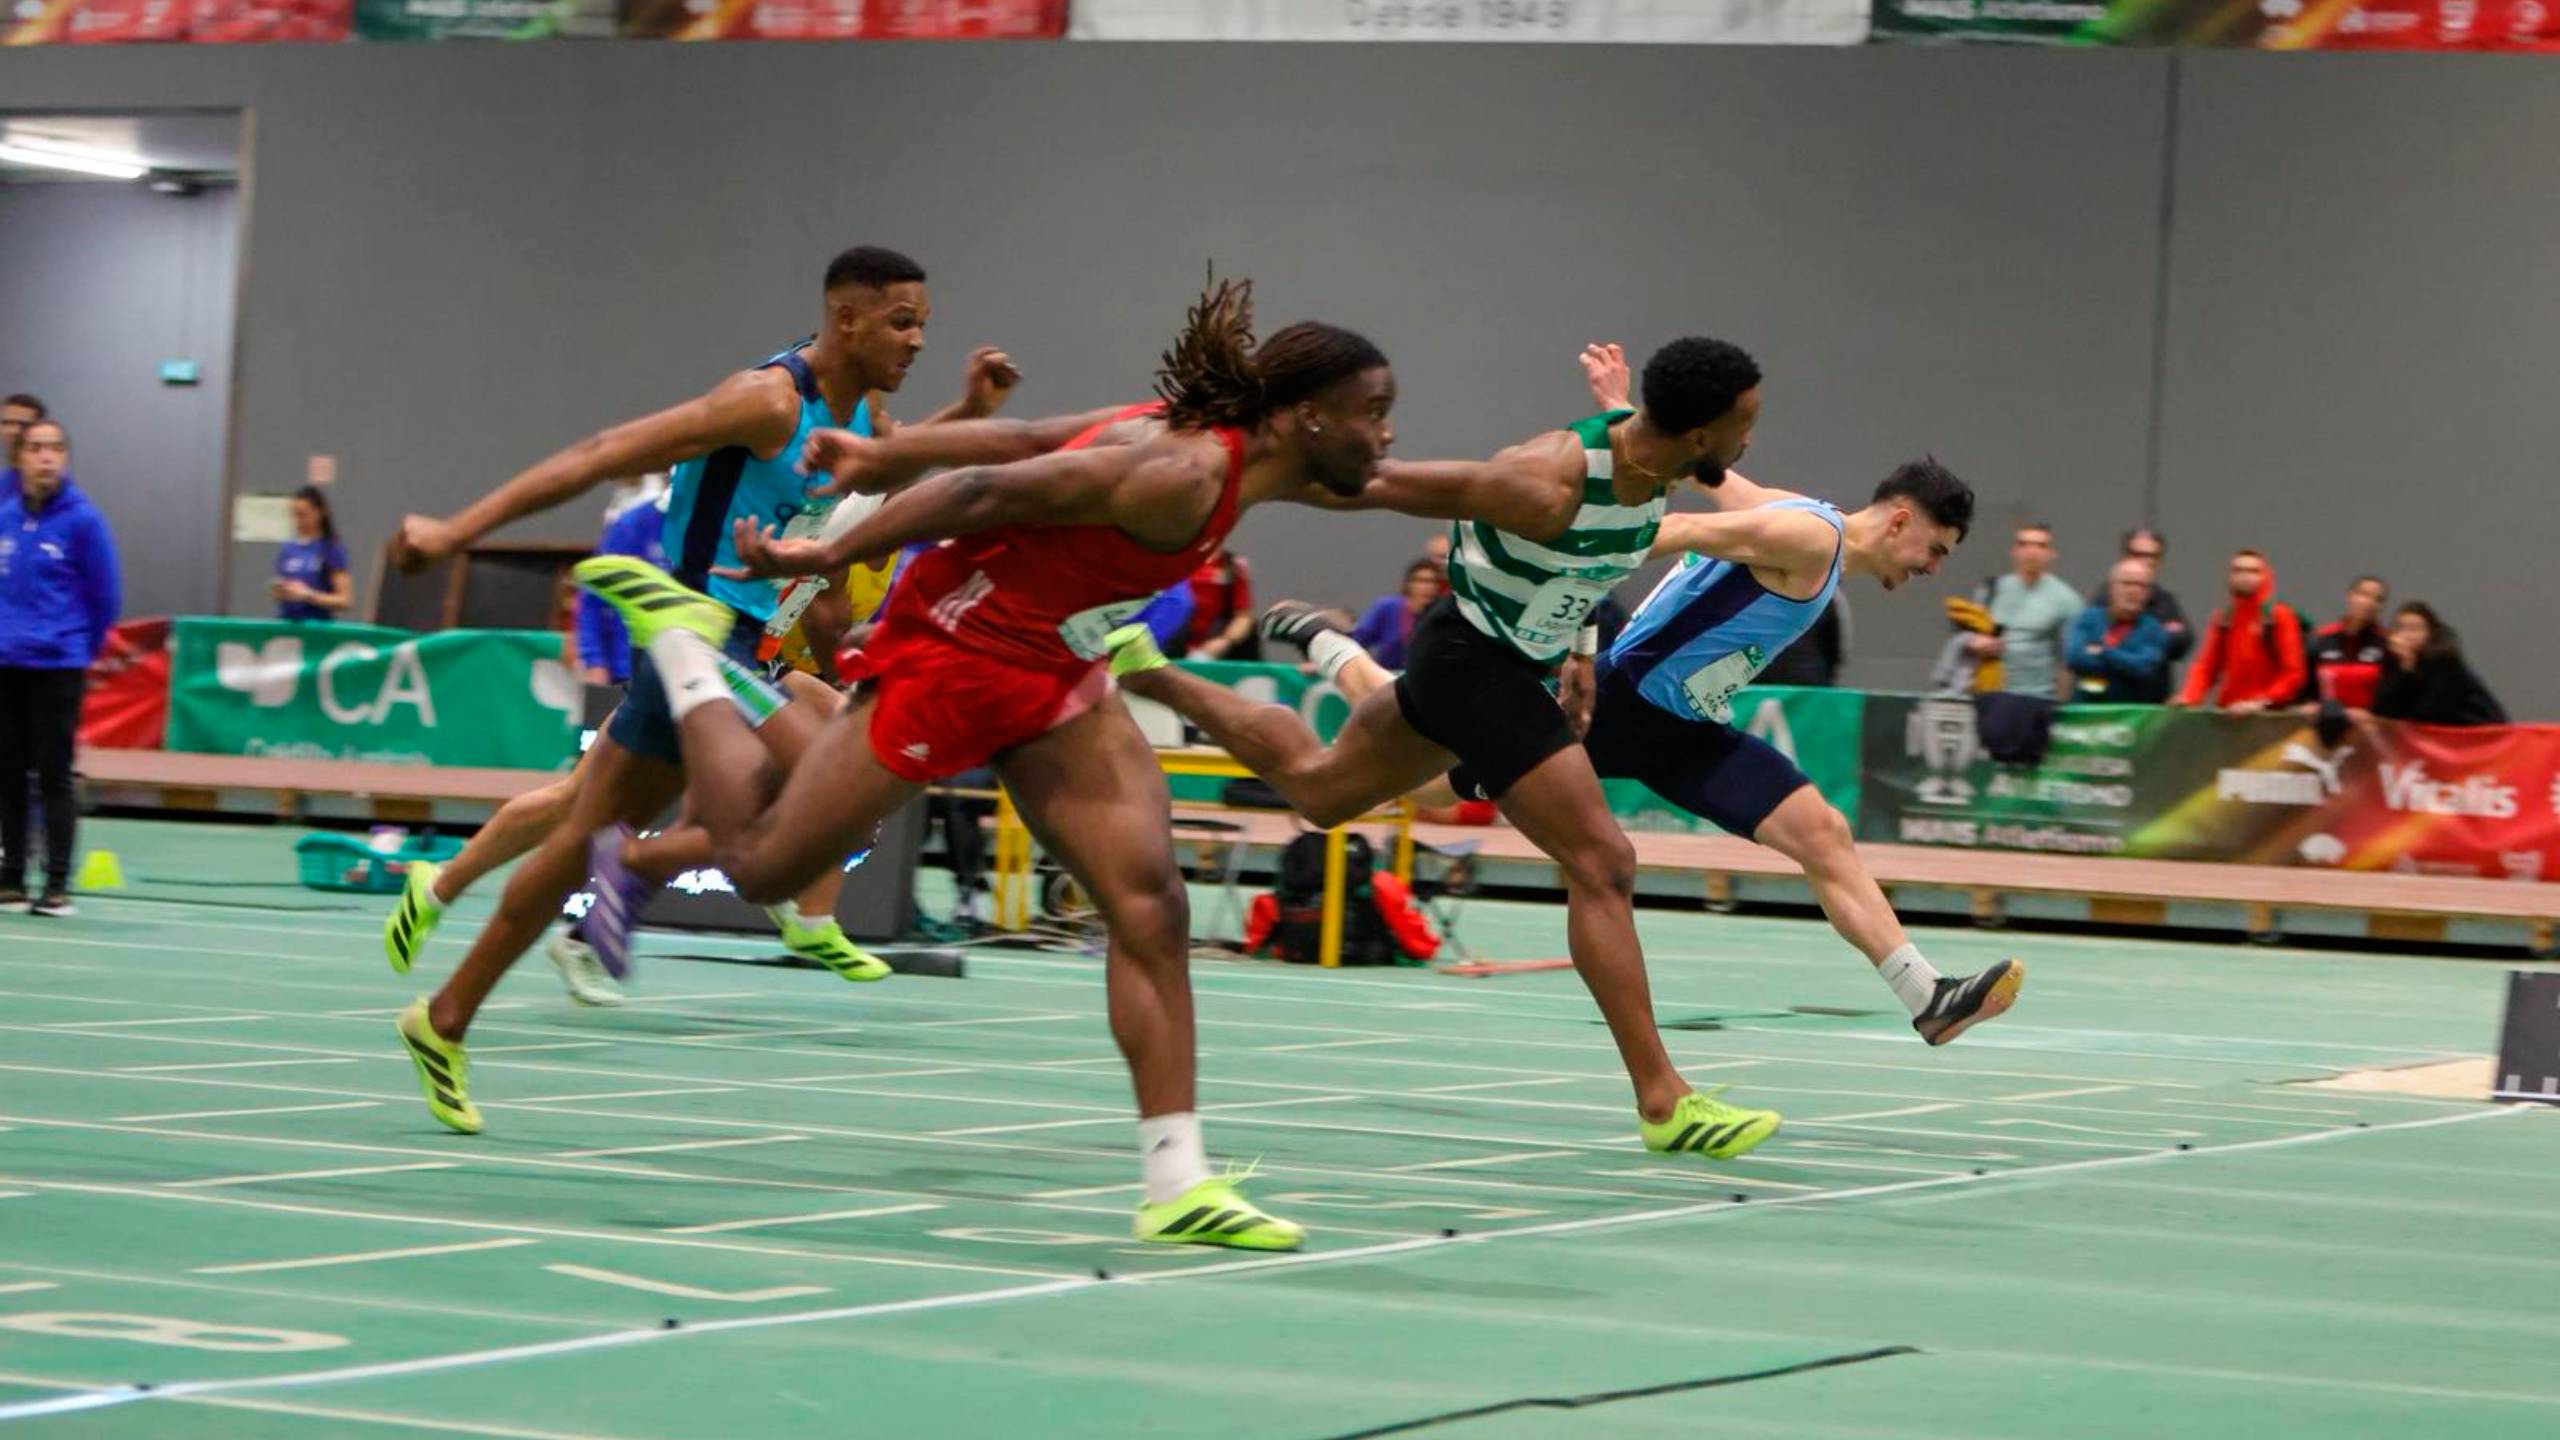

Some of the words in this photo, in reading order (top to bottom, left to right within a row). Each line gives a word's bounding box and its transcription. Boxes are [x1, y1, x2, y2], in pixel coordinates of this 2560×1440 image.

[316, 639, 437, 728] CA
[2378, 759, 2519, 818] Vitalis
[0, 1312, 352, 1353] 8
